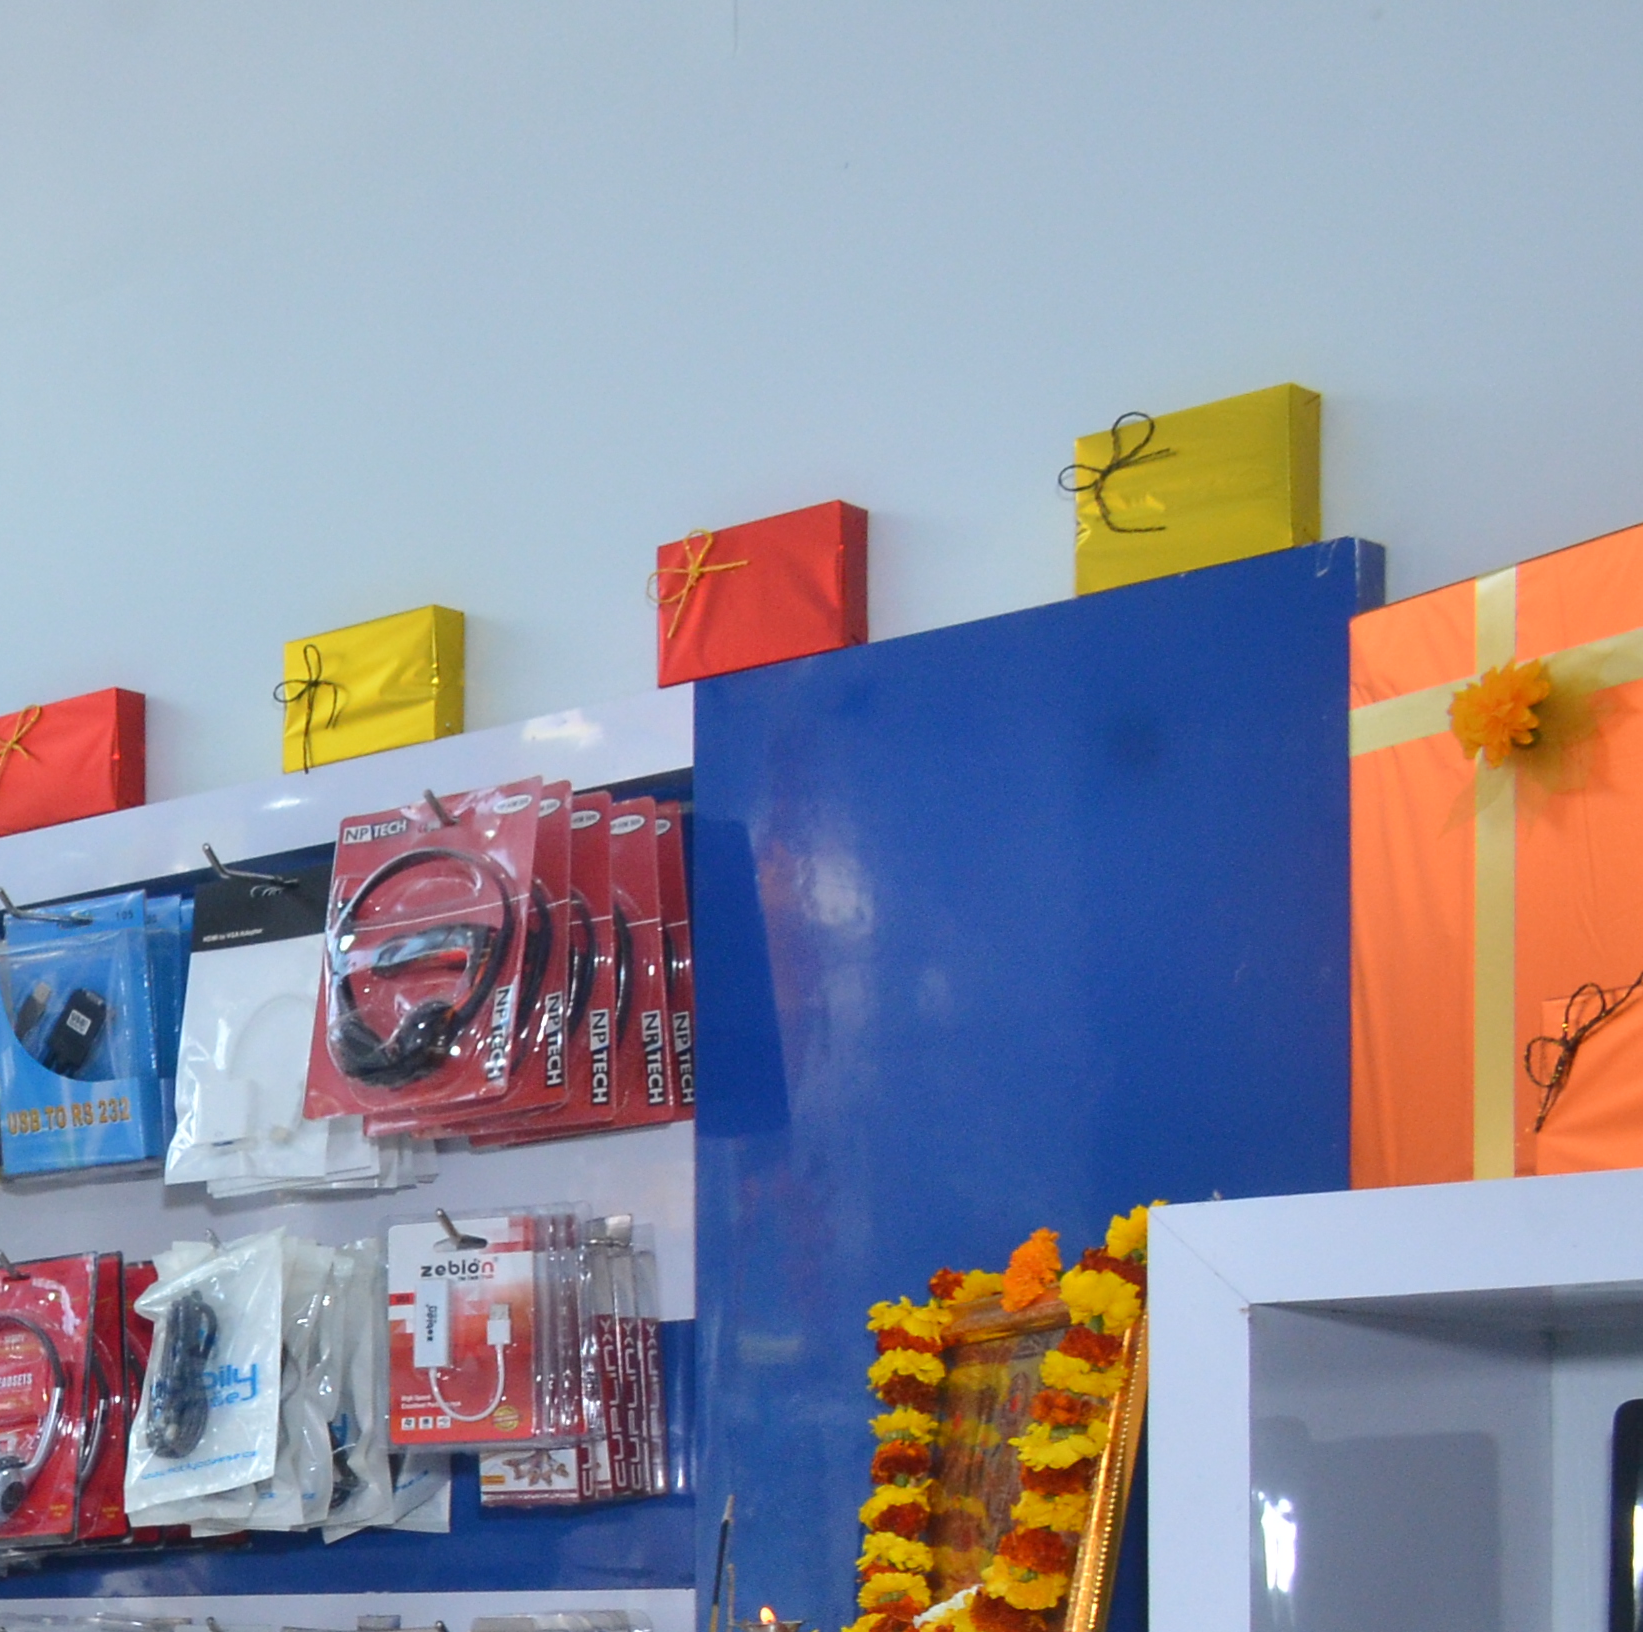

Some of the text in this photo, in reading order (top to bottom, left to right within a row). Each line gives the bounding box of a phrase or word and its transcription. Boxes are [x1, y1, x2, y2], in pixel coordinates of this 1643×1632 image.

[7, 1096, 131, 1136] USB TO RS 232
